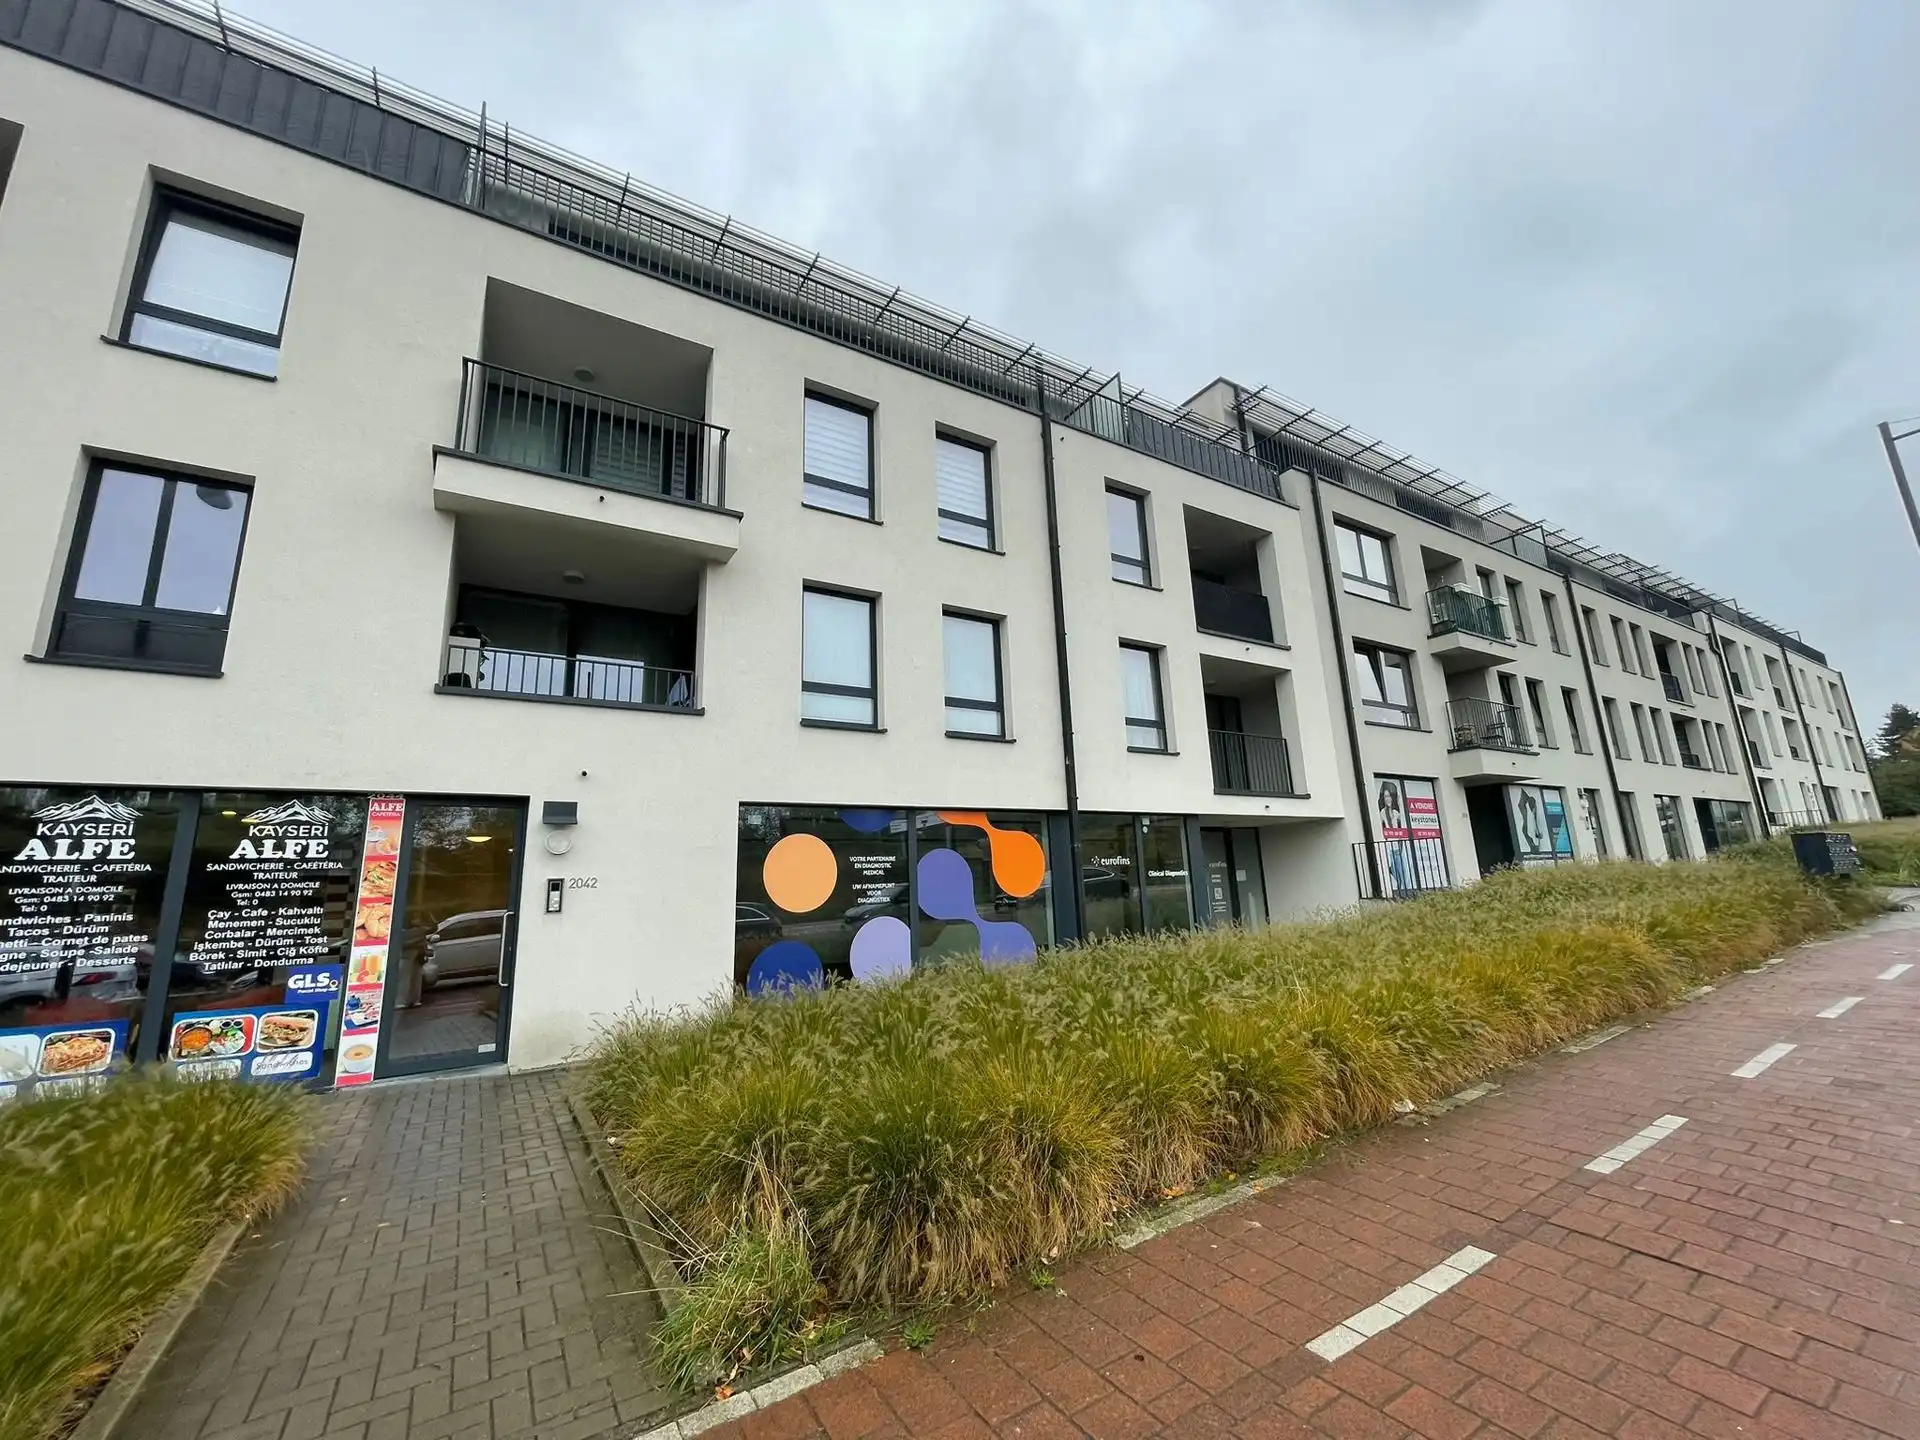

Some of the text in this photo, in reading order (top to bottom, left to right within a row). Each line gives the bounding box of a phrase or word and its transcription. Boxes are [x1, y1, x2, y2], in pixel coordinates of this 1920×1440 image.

[370, 802, 403, 811] ALFE
[36, 821, 135, 836] KAYSERİ
[249, 823, 329, 837] KAYSERİ
[13, 838, 136, 860] ALFE
[229, 839, 329, 860] ALFE
[1101, 856, 1131, 866] eurofins
[0, 864, 81, 874] NDWICHERIE
[206, 863, 285, 871] SANDWICHERIE
[43, 875, 98, 884] TRAITEUR
[253, 872, 299, 880] TRAITEUR
[1165, 870, 1189, 878] Diagnostics
[226, 883, 271, 891] LIVRAISON
[569, 877, 598, 889] 2042
[8, 887, 63, 895] LIVRAISON
[44, 895, 69, 903] 0483
[21, 905, 38, 913] Tel:
[208, 910, 232, 920] Çay
[242, 908, 269, 917] Cafe
[84, 913, 134, 923] Paninis
[208, 919, 265, 929] Menemen
[275, 917, 321, 926] Sucuklu
[8, 928, 50, 937] Tacos
[63, 925, 109, 935] Dürüm
[205, 929, 257, 940] Corbalar
[267, 926, 321, 937] Mercimek
[42, 936, 89, 947] Cornet
[92, 935, 109, 944] de
[112, 934, 149, 945] pates
[255, 937, 294, 947] Dürüm
[305, 936, 328, 944] Tost
[40, 949, 85, 959] Soupe
[189, 951, 226, 962] Börek
[236, 949, 267, 958] Simit
[277, 948, 297, 957] Ciğ
[300, 946, 329, 955] Köfte
[76, 956, 137, 967] Desserts
[254, 957, 314, 968] Dondurma
[288, 972, 331, 989] GLS
